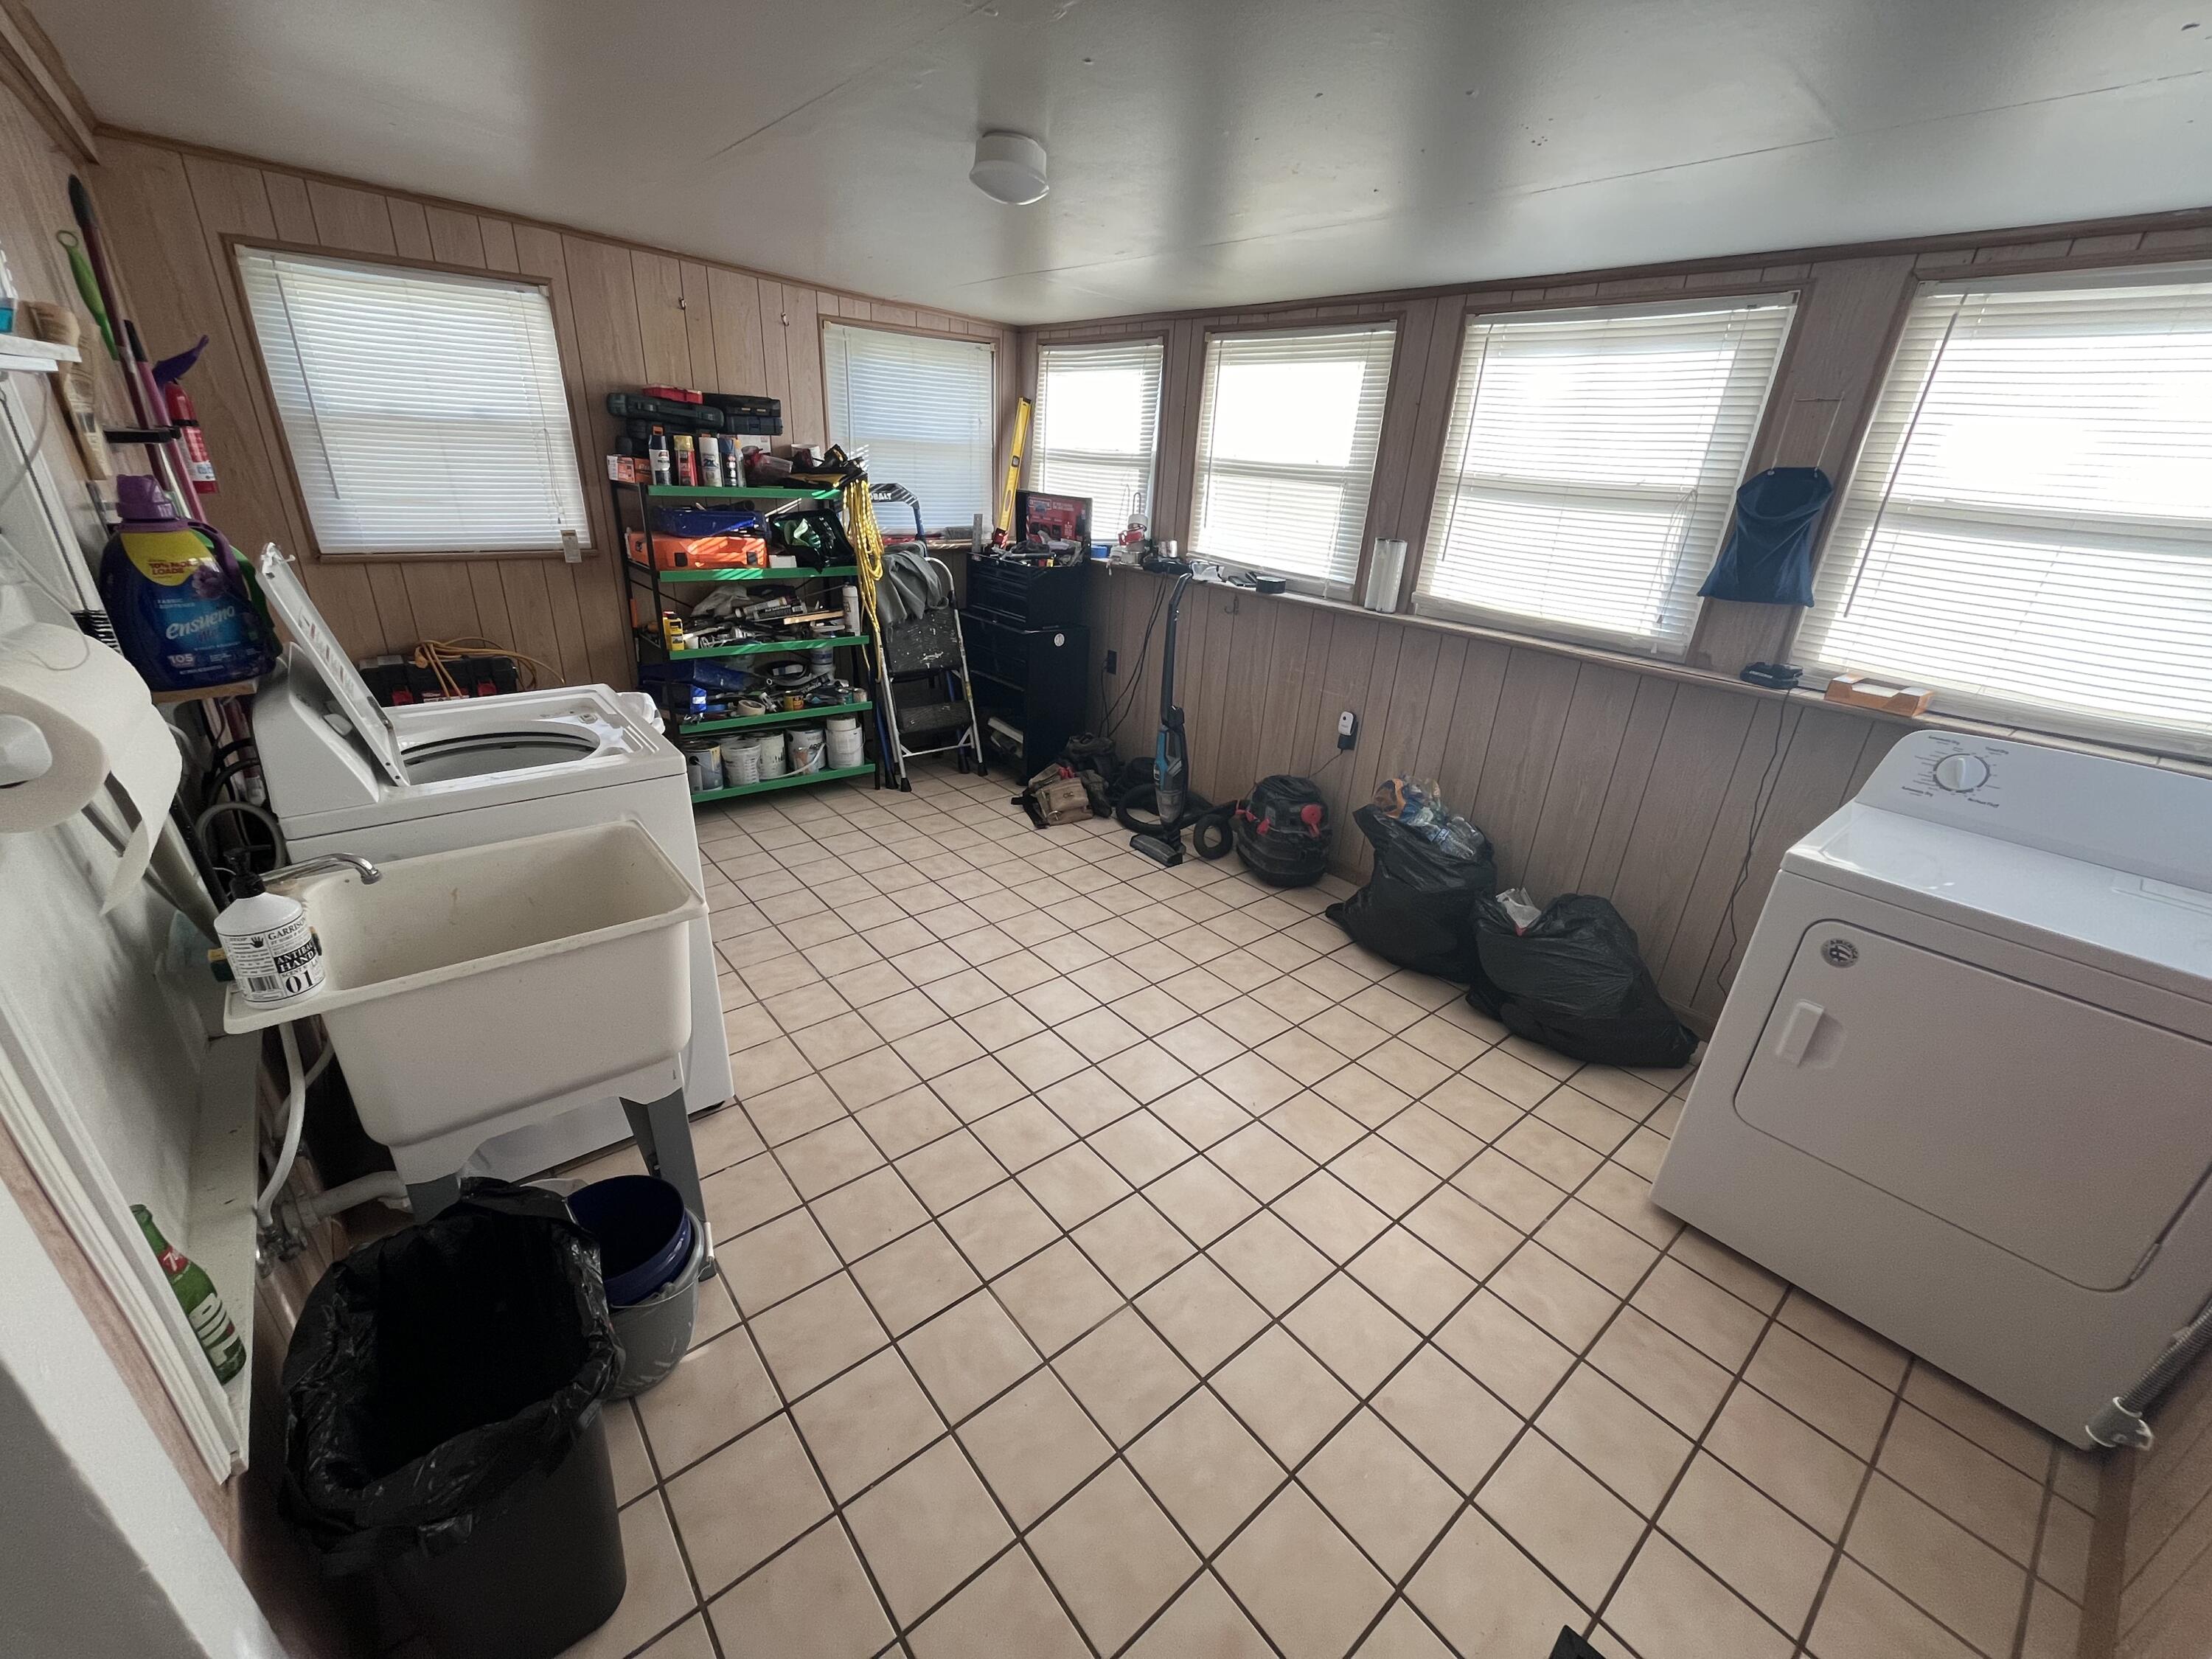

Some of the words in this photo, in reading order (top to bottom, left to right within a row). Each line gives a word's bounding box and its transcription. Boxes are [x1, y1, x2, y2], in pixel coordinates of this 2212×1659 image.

[869, 492, 892, 501] OBALT
[153, 567, 184, 575] LOADS
[168, 653, 194, 664] 105
[279, 950, 314, 973] HAND
[285, 970, 313, 993] 01
